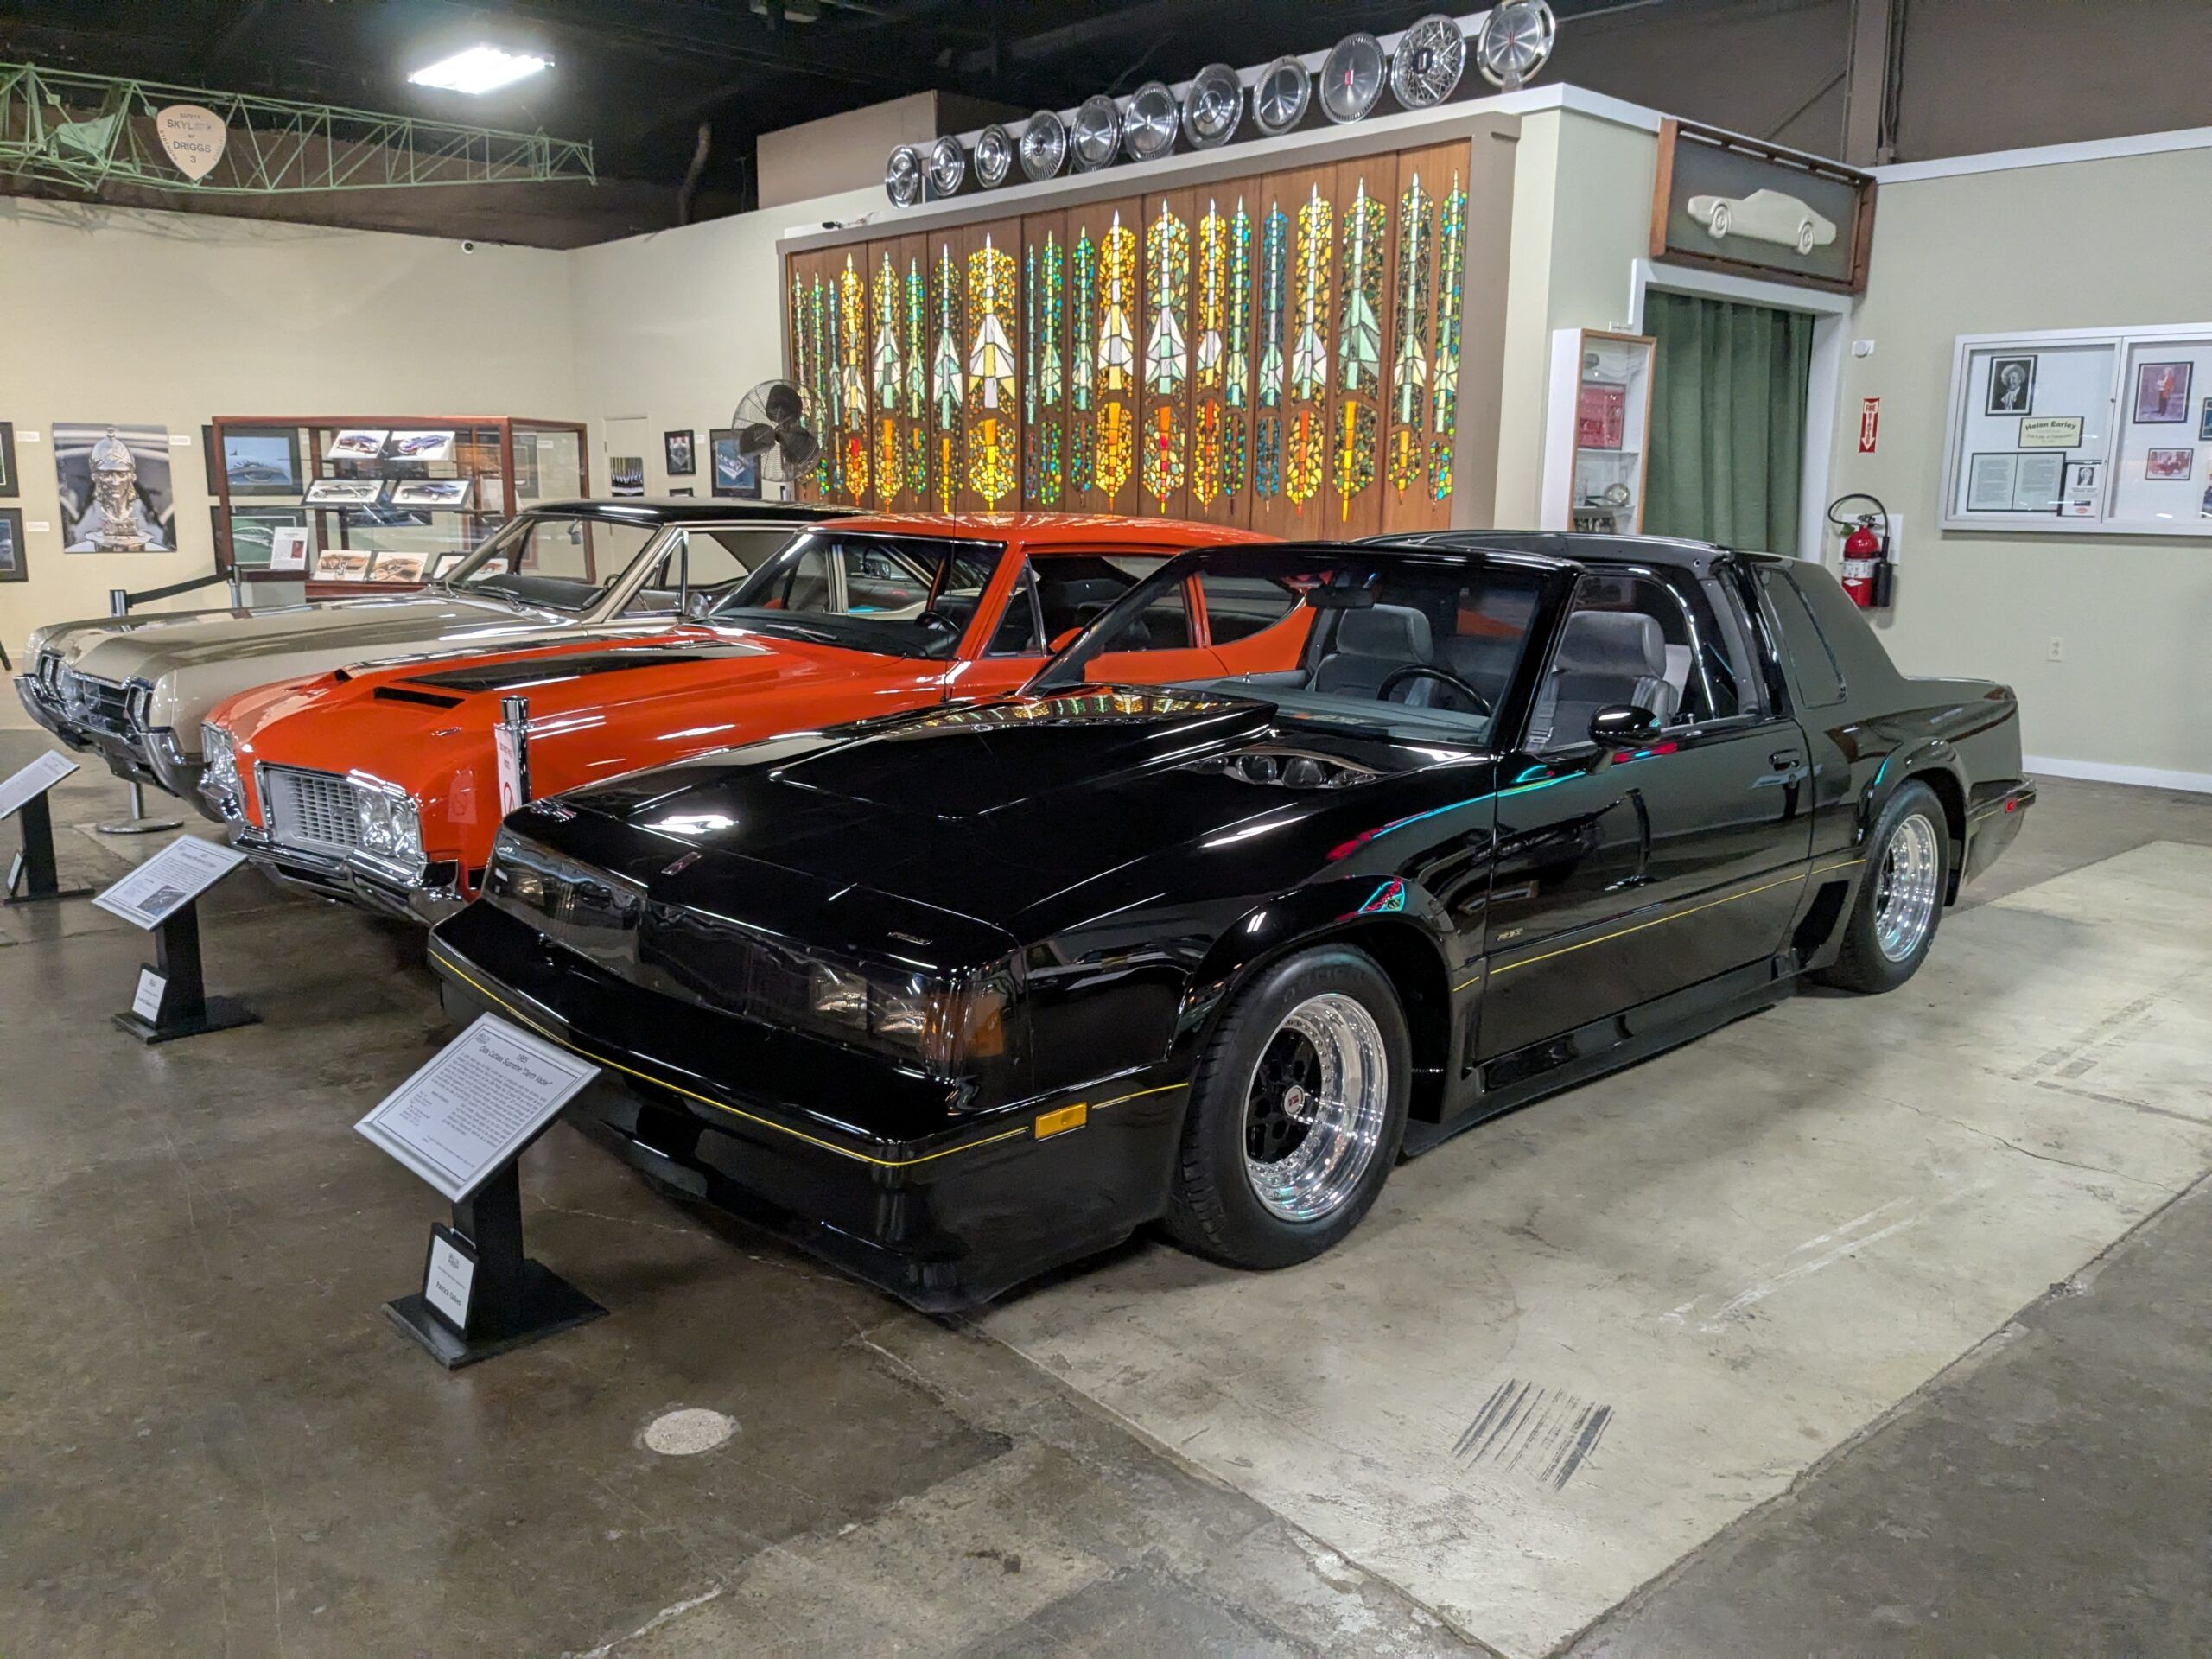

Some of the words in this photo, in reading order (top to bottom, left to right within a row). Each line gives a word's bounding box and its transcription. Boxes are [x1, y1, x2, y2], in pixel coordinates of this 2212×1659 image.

[173, 141, 212, 154] DRIGGS
[190, 155, 197, 164] 3
[2050, 421, 2077, 430] Earley
[488, 1051, 505, 1062] Cutlass
[502, 1058, 524, 1072] Supreme
